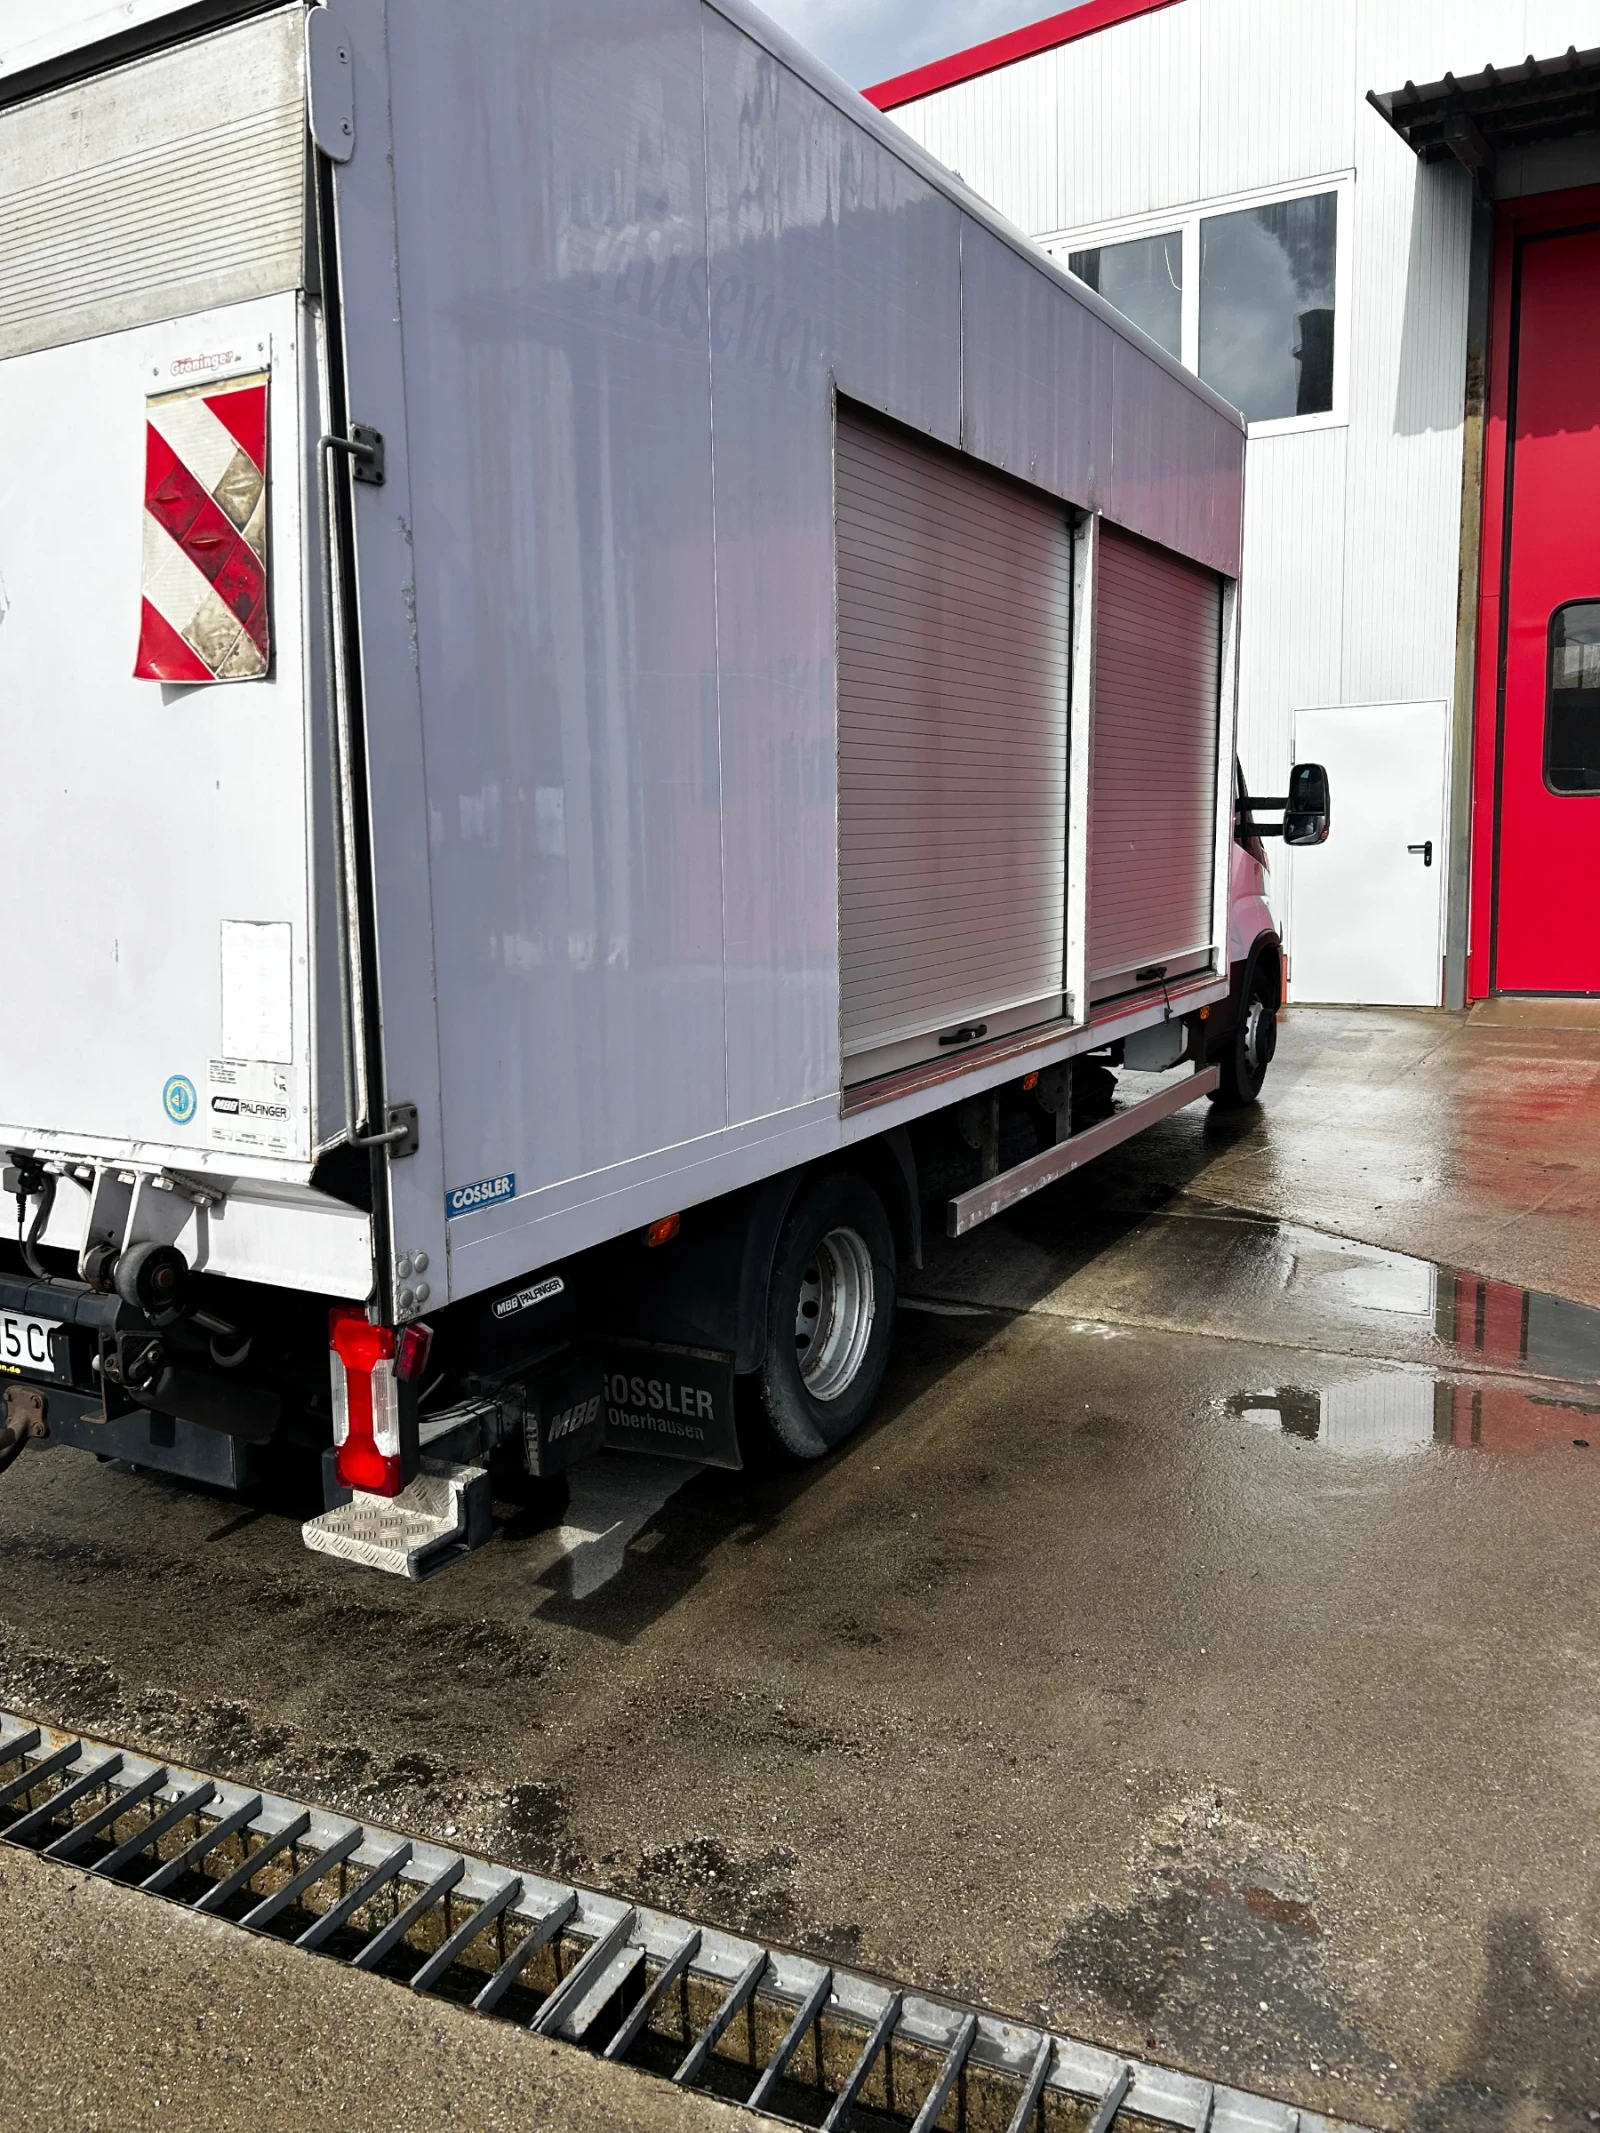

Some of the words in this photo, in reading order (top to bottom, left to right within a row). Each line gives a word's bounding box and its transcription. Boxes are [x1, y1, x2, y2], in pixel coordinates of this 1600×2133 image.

[214, 1099, 239, 1112] MBB
[240, 1102, 287, 1119] PALFINGER
[452, 1177, 510, 1208] GOSSLER
[497, 1295, 519, 1315] MBB
[519, 1279, 562, 1305] PALFINGER
[548, 1395, 600, 1442] MBB
[608, 1408, 704, 1441] Oberhausen
